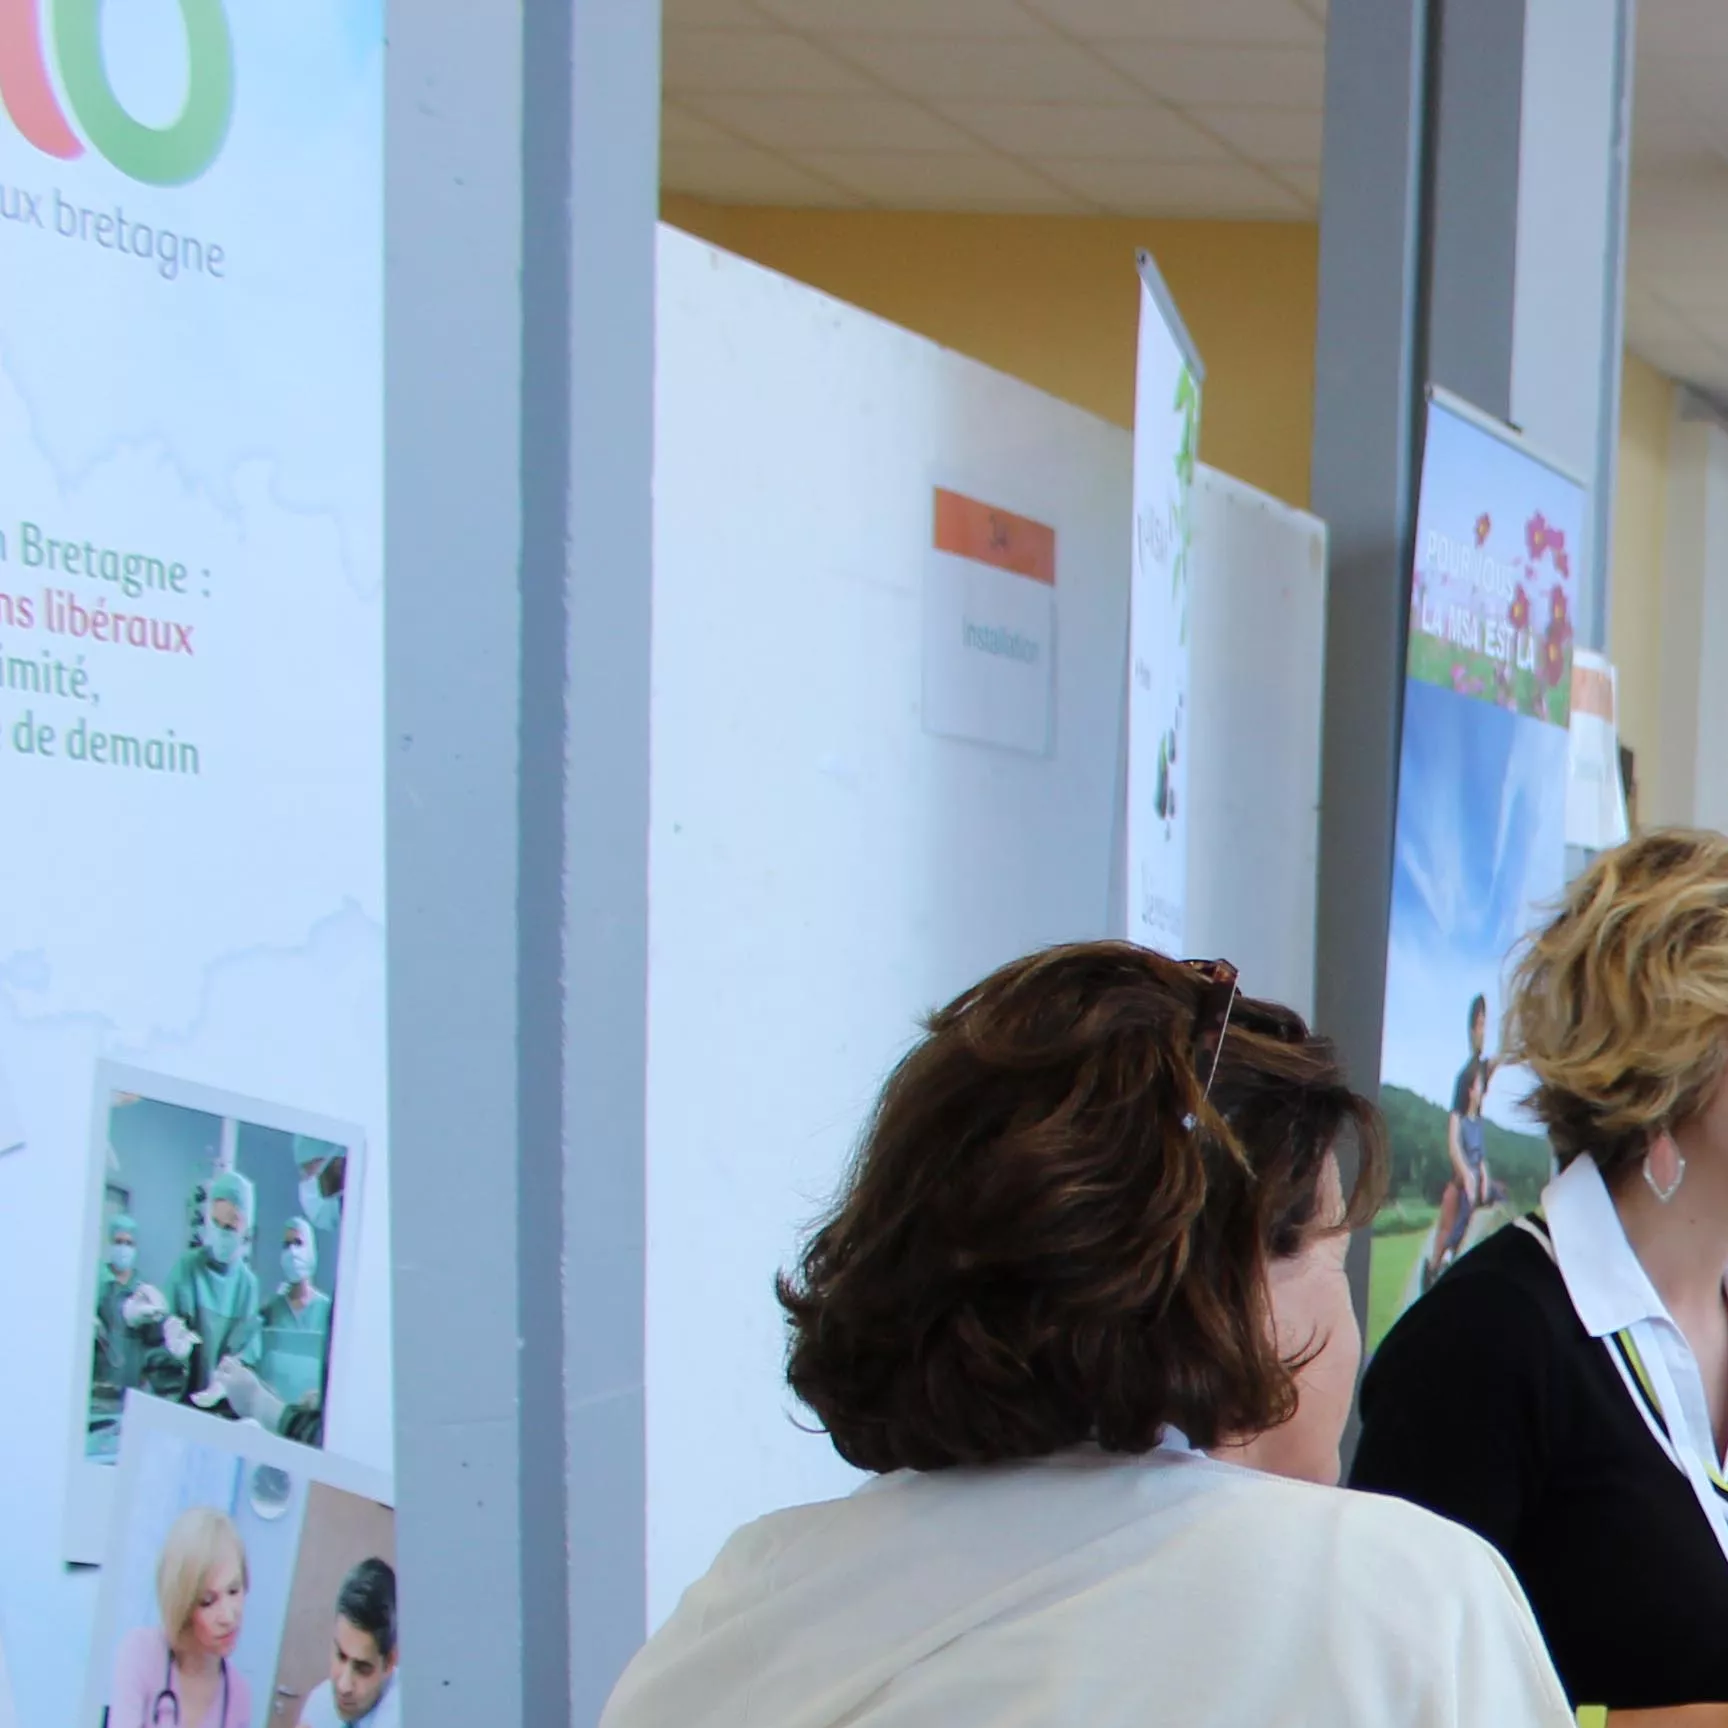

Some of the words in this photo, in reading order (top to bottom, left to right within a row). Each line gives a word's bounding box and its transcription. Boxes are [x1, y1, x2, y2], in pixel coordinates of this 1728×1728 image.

[53, 187, 225, 281] bretagne
[20, 521, 188, 599] Bretagne
[1427, 529, 1471, 580] POUR
[44, 587, 194, 657] libéraux
[1422, 594, 1444, 637] LA
[13, 709, 56, 757] de
[65, 716, 200, 774] demain
